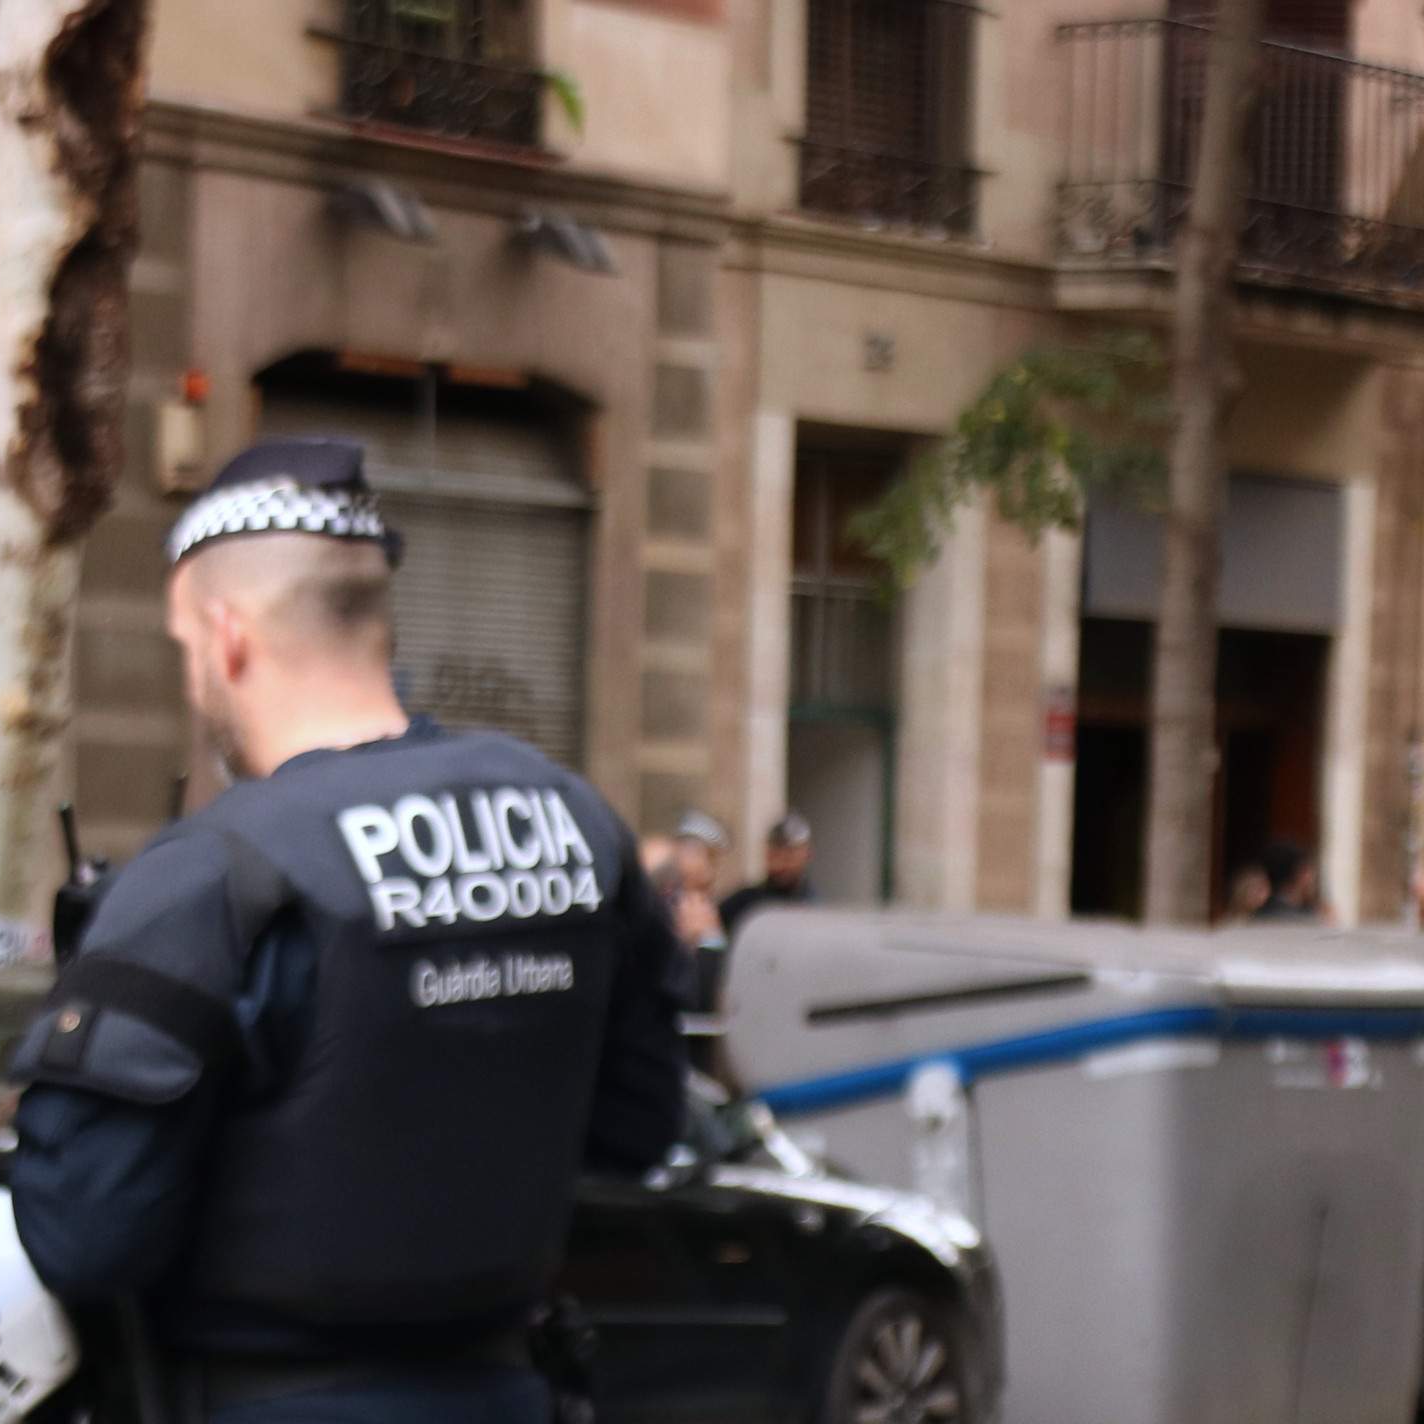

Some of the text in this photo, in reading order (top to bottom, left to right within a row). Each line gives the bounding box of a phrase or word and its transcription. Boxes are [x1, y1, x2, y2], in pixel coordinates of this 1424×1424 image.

[337, 786, 595, 883] POLICIA
[369, 867, 603, 931] R40004
[504, 952, 575, 998] Urbana
